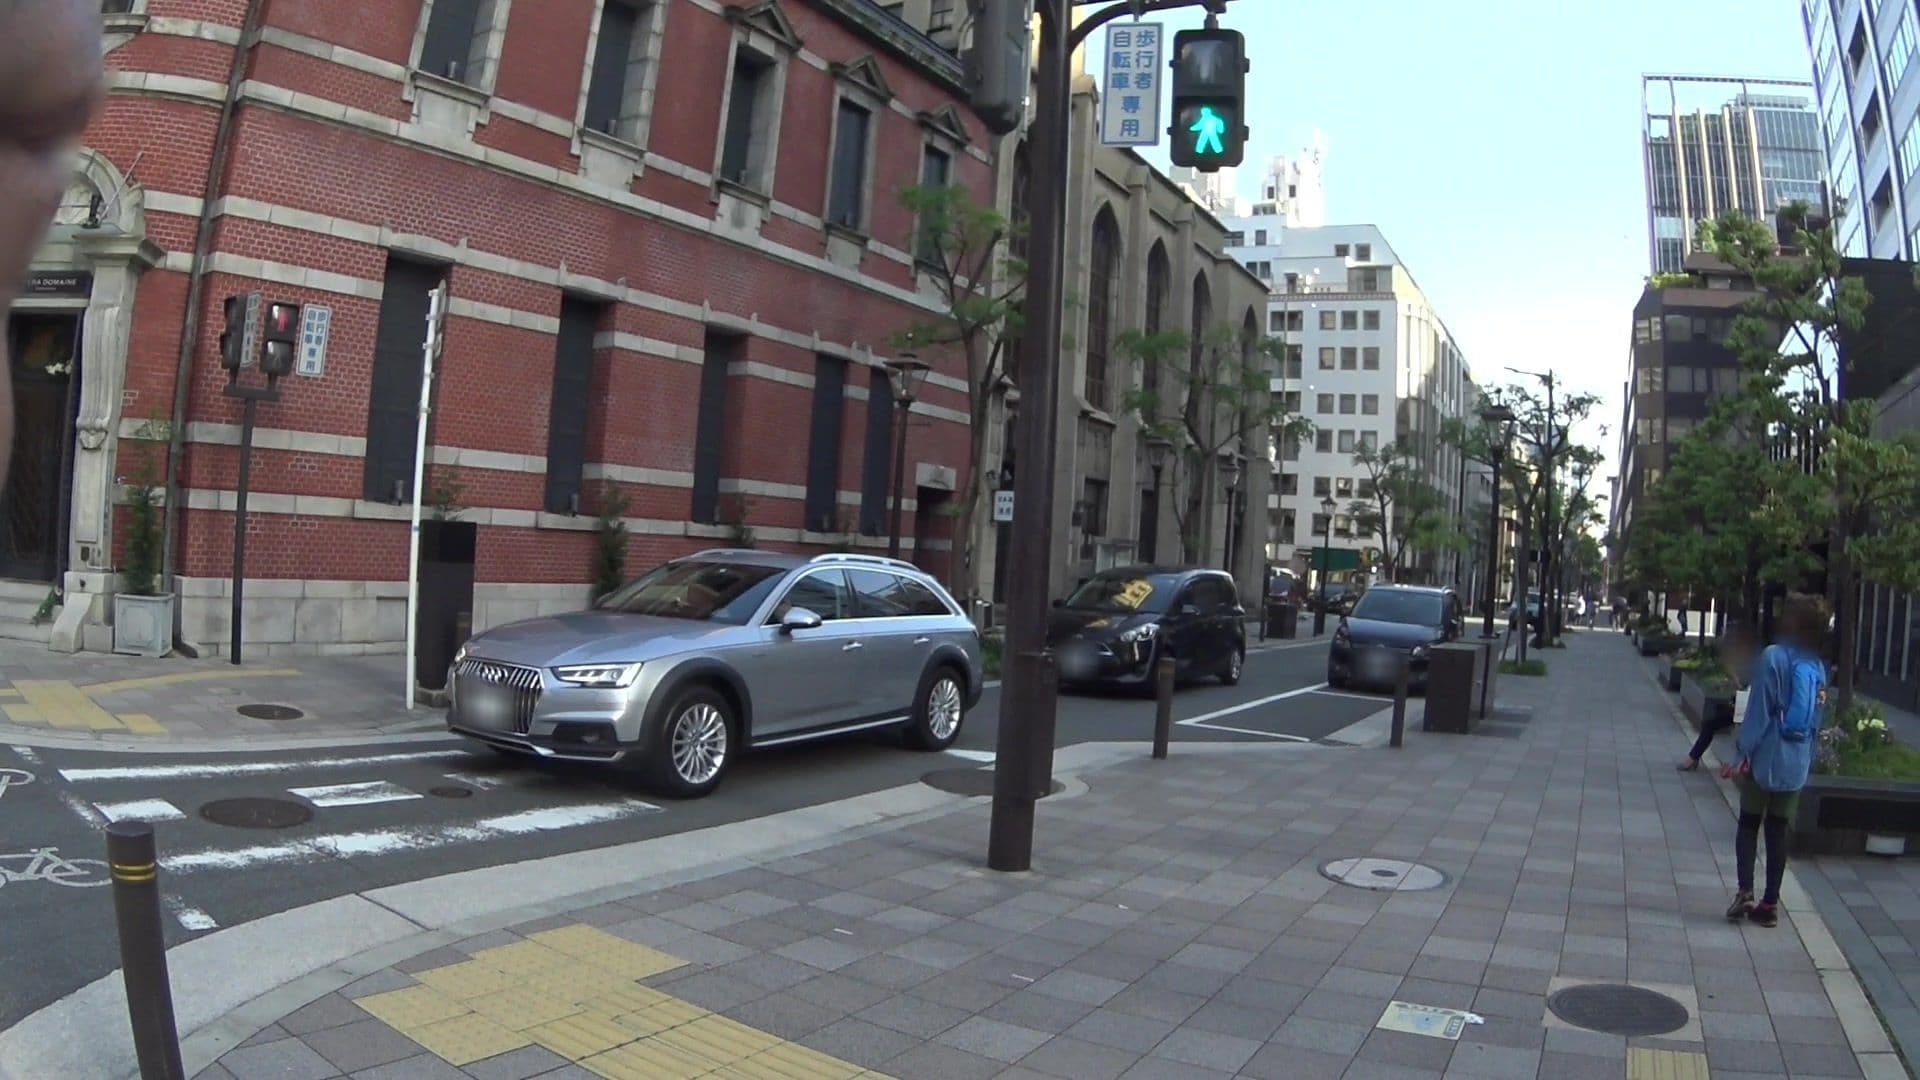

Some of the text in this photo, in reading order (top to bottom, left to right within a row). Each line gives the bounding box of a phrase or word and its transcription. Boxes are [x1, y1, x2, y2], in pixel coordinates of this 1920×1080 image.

[1112, 31, 1132, 90] 自転車
[1135, 30, 1156, 89] 歩行者
[1120, 96, 1141, 137] 専用
